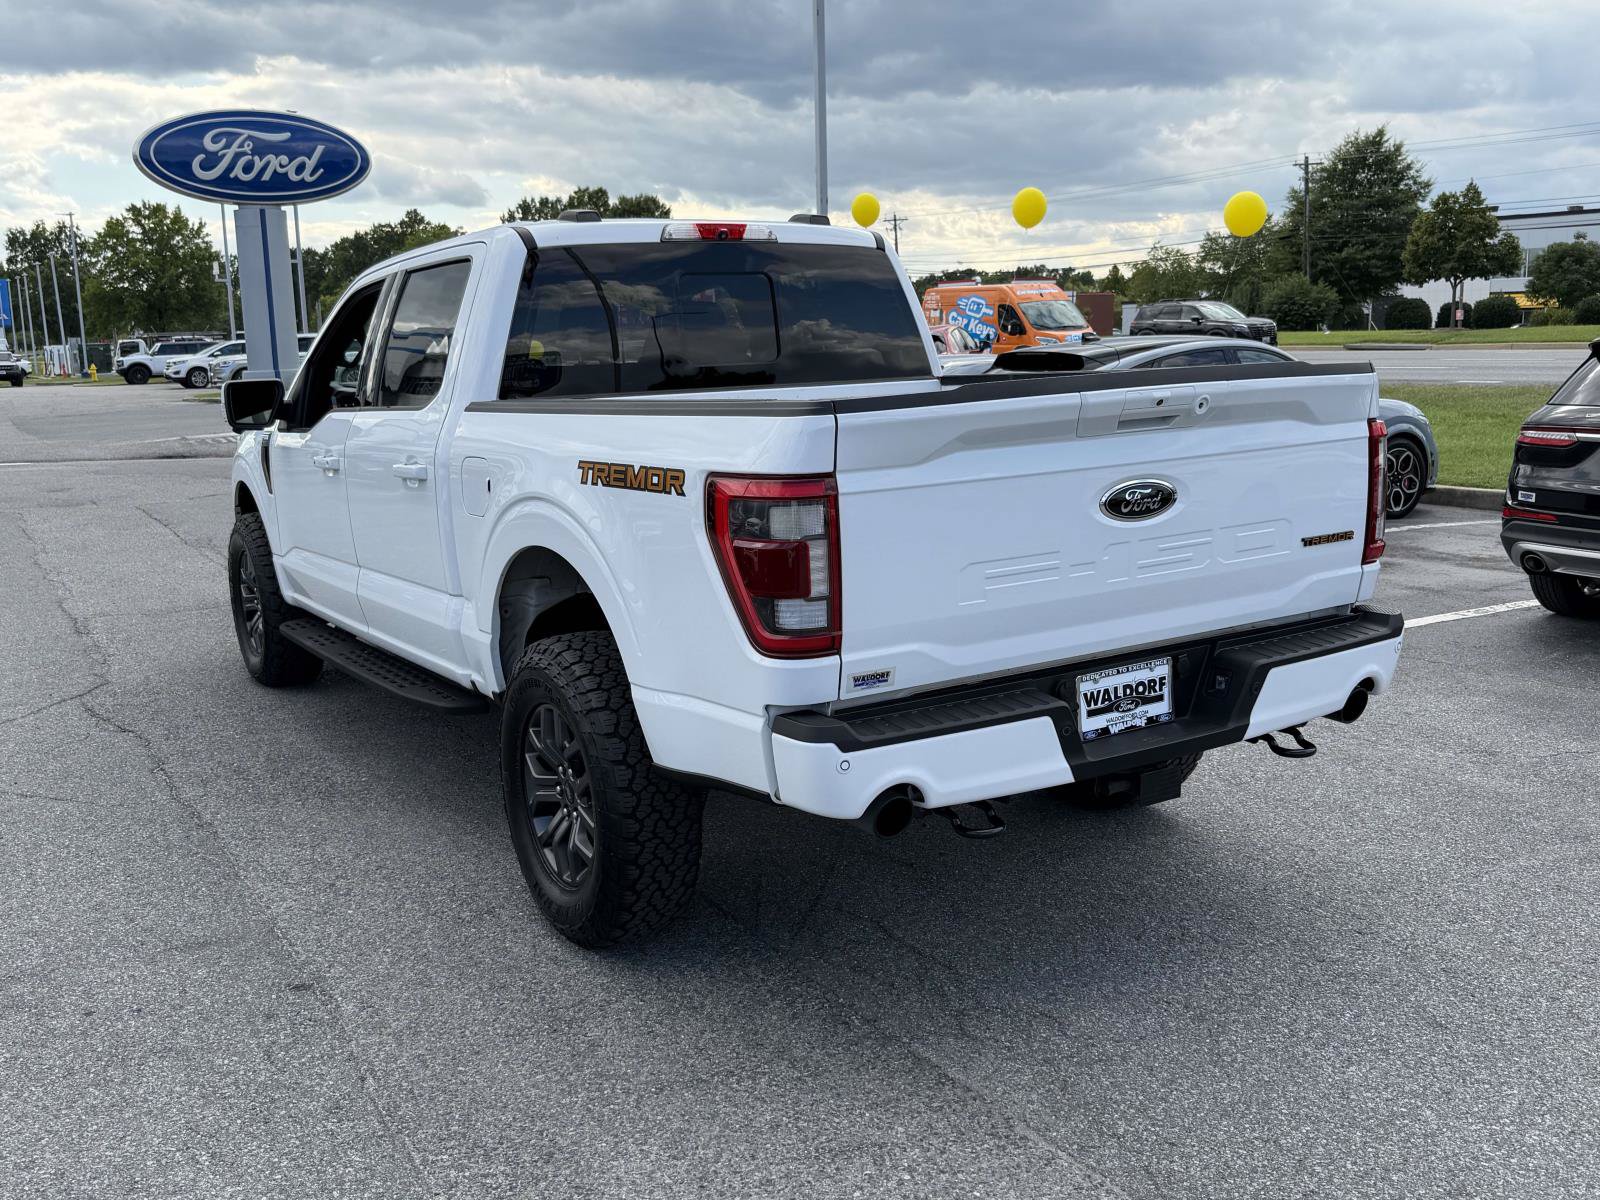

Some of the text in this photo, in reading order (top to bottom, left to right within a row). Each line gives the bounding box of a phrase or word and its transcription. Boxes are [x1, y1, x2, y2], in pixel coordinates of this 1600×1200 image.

[191, 127, 326, 183] Ford
[948, 310, 969, 328] Car
[577, 460, 686, 497] TREMOR
[1120, 488, 1163, 513] Ford
[1301, 530, 1355, 547] TREMOR
[852, 671, 891, 683] WALDORF
[1082, 669, 1118, 682] DEDICATED
[1128, 659, 1168, 672] EXCELLENCE
[1083, 676, 1167, 708] WALDORF
[1108, 717, 1148, 735] WALDORF
